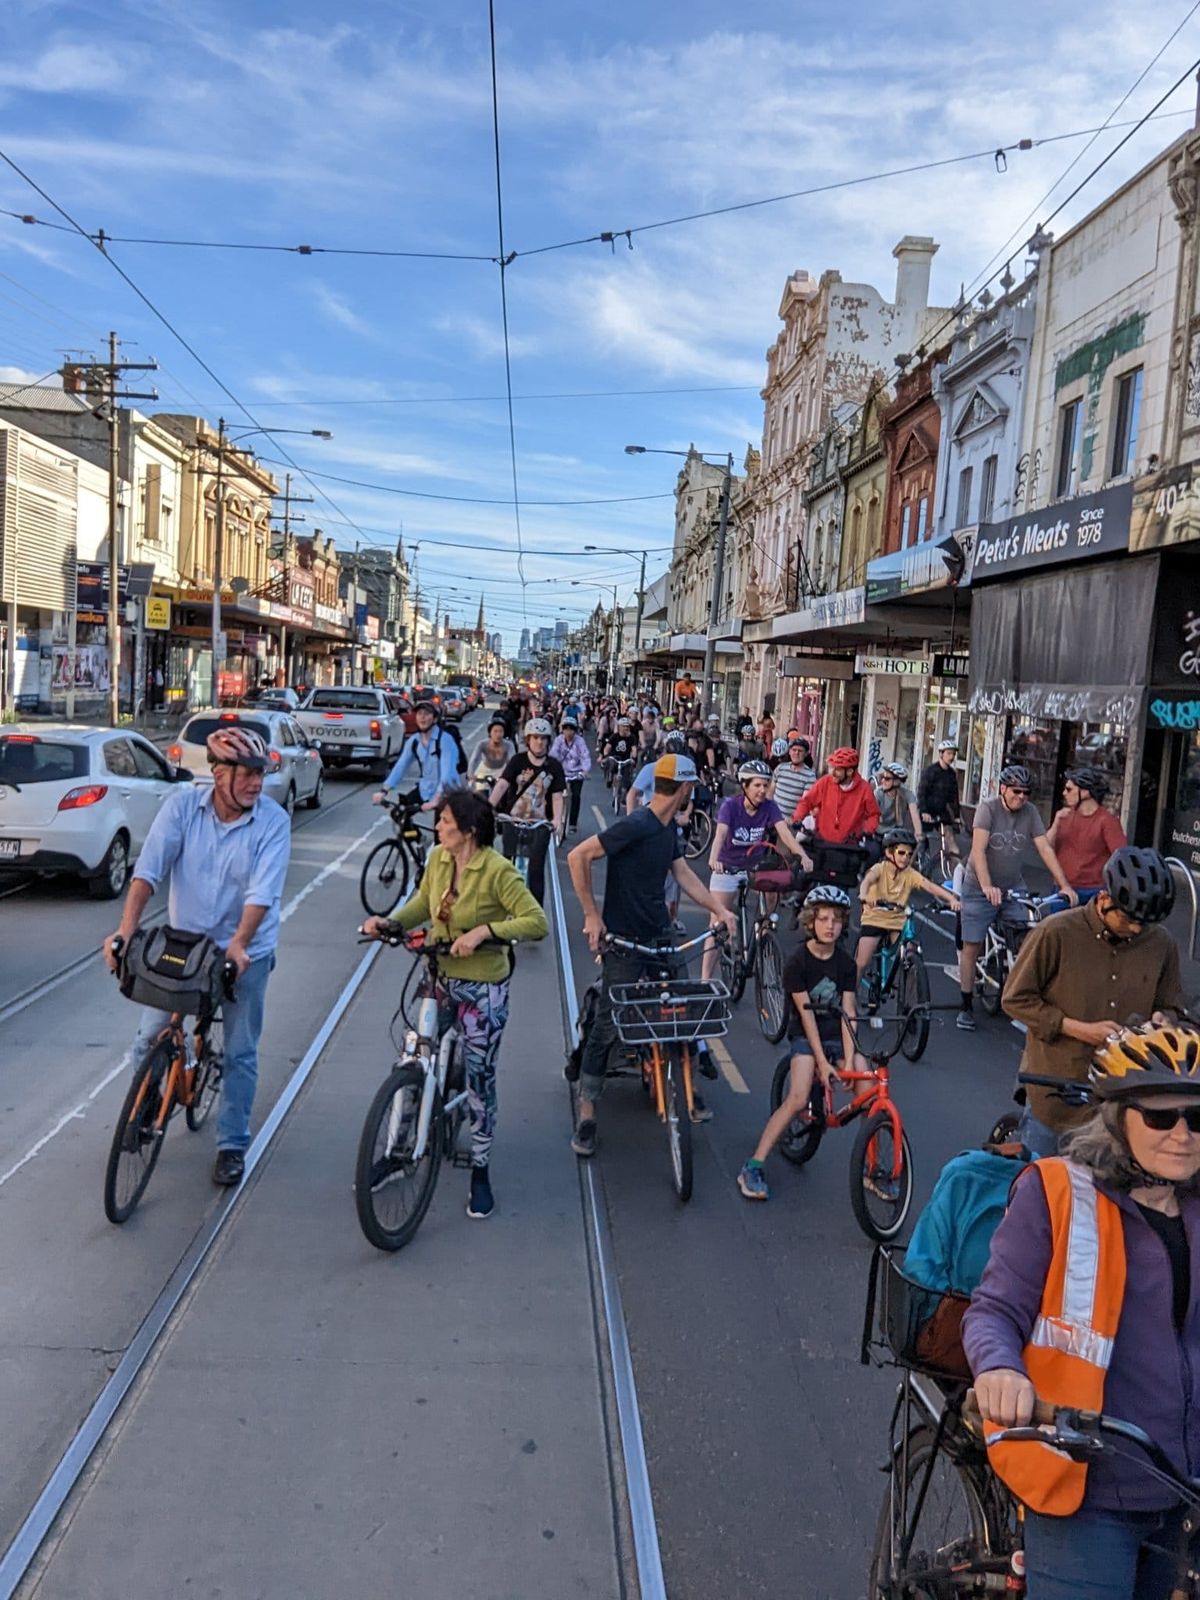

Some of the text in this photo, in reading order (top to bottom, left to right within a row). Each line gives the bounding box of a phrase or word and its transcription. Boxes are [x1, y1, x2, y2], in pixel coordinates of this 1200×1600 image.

[1079, 507, 1104, 524] Since
[974, 525, 1020, 567] Peter's
[1021, 519, 1070, 556] Meats
[1077, 522, 1102, 547] 1978
[885, 660, 917, 674] HOT
[309, 726, 357, 738] TOYOTA
